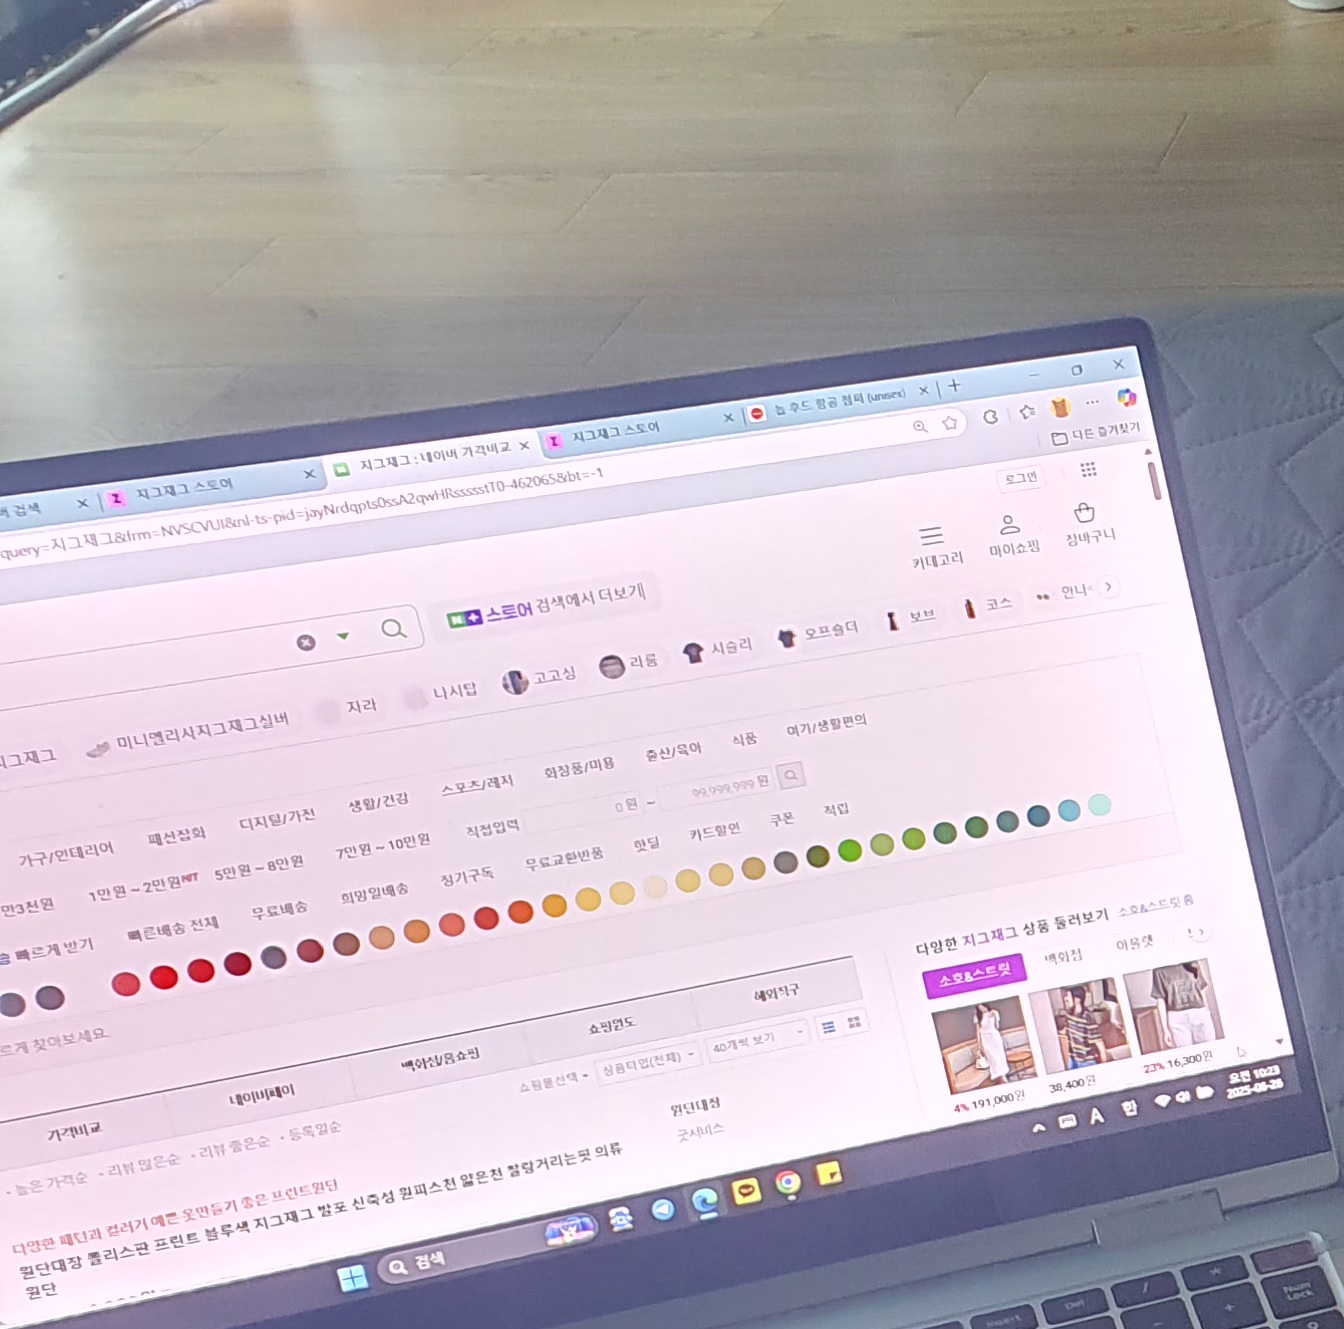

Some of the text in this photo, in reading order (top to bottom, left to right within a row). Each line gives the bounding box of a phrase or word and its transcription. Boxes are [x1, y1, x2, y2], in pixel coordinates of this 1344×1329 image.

[573, 421, 661, 444] 지그재그 스토어
[361, 442, 512, 472] 지그재그 네이버 가격비교
[137, 477, 233, 500] 지그재그 스토어
[1006, 472, 1038, 486] 로그인
[14, 502, 42, 516] 검색
[1065, 528, 1117, 547] 장바구니
[989, 540, 1041, 558] 마이쇼핑
[912, 551, 964, 571] 카테고리
[486, 582, 647, 624] 스토어 검색에서 더보기
[987, 597, 1013, 611] 코스
[910, 609, 937, 624] 보브
[805, 620, 860, 641] 오프숄더
[712, 637, 753, 657] 시슬리
[534, 665, 577, 685] 고고싱
[433, 682, 477, 701] 나시탑
[347, 697, 378, 715] 자라
[732, 731, 759, 747] 식품
[646, 741, 703, 763] 출산/육아
[544, 756, 616, 781] 화장품/미용
[441, 773, 515, 798] 스포츠/레저
[348, 792, 410, 814] 생활/건강
[625, 797, 638, 812] 원
[824, 801, 851, 818] 적립
[239, 807, 317, 832] 디지털/가전
[466, 818, 521, 840] 직접입력
[770, 811, 796, 828] 쿠폰
[147, 825, 207, 848] 패션잡화
[689, 822, 742, 842] 카드할인
[19, 840, 115, 869] 가구/인테리어
[336, 832, 432, 861] 7만원 10만원
[634, 836, 661, 854] 핫딜
[214, 854, 305, 882] 5만원 8만원
[525, 846, 605, 872] 무료교환반품
[441, 865, 495, 888] 정기구독
[88, 886, 127, 904] 1만원
[142, 876, 182, 895] 2만원
[252, 901, 309, 922] 무료배송
[128, 916, 221, 943] 빠른배송 전체
[915, 908, 1110, 956] 다양한 지그재그 상품 둘러보기
[15, 945, 61, 964] 빠르게
[753, 983, 801, 1002] 해외직구
[33, 1026, 111, 1050] 찾아보세요
[753, 1032, 776, 1046] 보기
[229, 1083, 296, 1107] 네이버페이
[671, 1096, 722, 1118] 원단대장
[48, 1122, 103, 1142] 가격비교
[199, 1143, 227, 1159] 리뷰
[109, 1162, 136, 1178] 리뷰
[47, 1172, 89, 1189] 가격순
[12, 1236, 57, 1257] 다양한
[60, 1227, 103, 1247] 패턴과
[272, 1178, 339, 1202] 프린트원단
[19, 1255, 83, 1281] 원단대장
[88, 1242, 151, 1266] 폴리스판
[155, 1231, 202, 1251] 프린트
[253, 1208, 315, 1231] 지그재그
[317, 1201, 349, 1219] 발포
[352, 1190, 396, 1211] 신축성
[399, 1177, 458, 1201] 원피스천
[595, 1142, 624, 1158] 의류
[415, 1250, 447, 1271] 검색
[25, 1282, 58, 1301] 원단
[1283, 1280, 1312, 1294] Num
[1286, 1288, 1315, 1302] Lock
